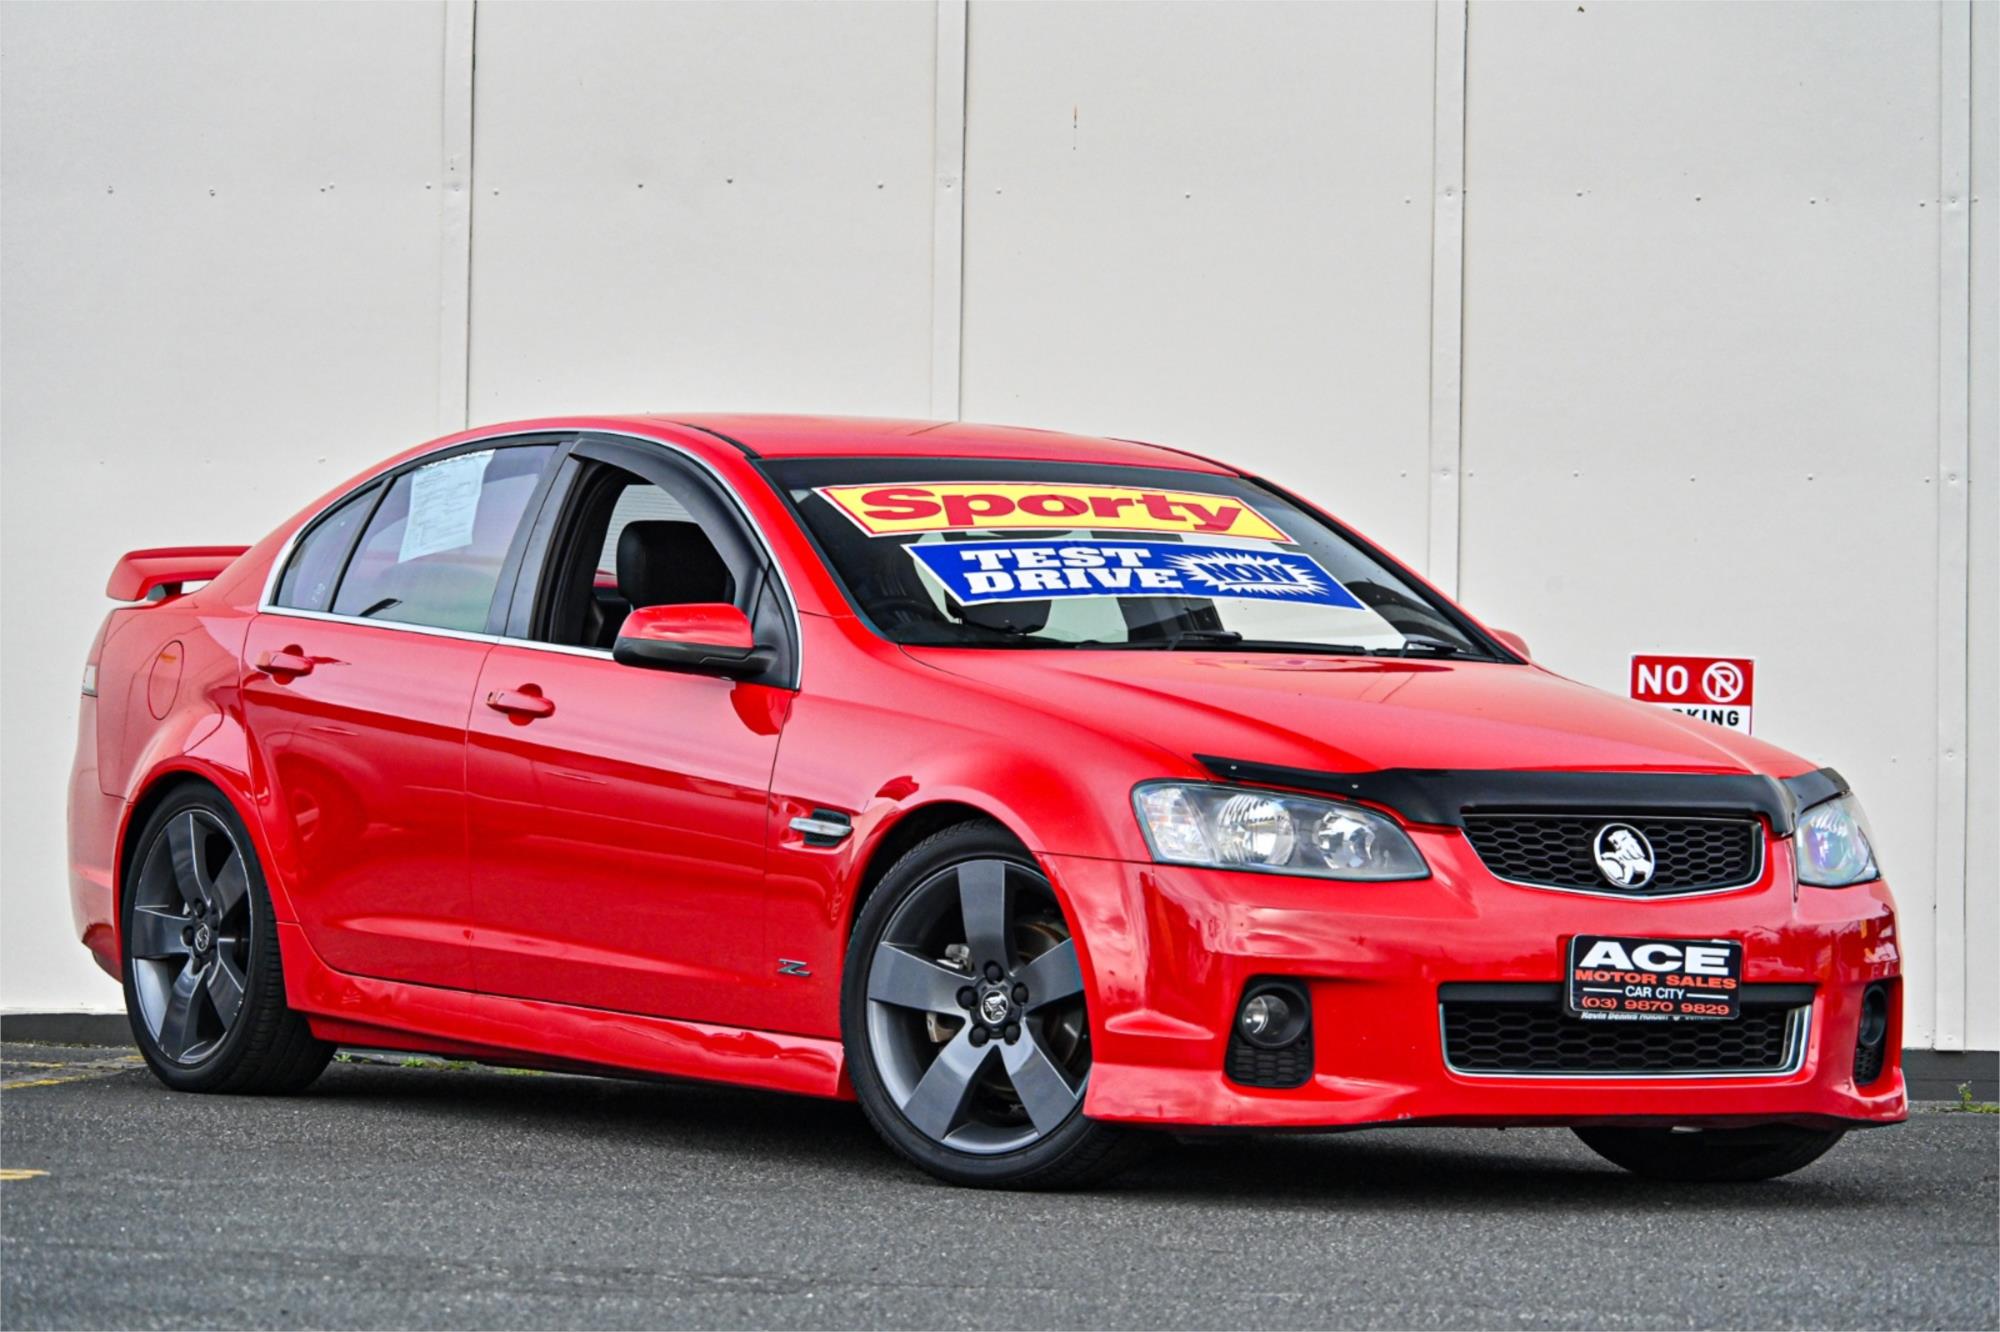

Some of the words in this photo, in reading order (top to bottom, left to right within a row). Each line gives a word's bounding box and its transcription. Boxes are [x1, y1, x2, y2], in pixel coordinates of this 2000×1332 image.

[861, 487, 1242, 532] Sporty
[961, 546, 1152, 571] TEST
[964, 568, 1184, 594] DRIVE
[1193, 562, 1299, 583] NOW
[1637, 663, 1689, 696] NO
[777, 958, 812, 977] Z
[1578, 941, 1731, 976] ACE
[1575, 970, 1658, 985] MOTOR
[1666, 974, 1737, 990] SALES
[1625, 985, 1652, 998] CAR
[1655, 987, 1685, 1000] CITY
[1581, 995, 1618, 1010] (03)
[1624, 998, 1674, 1013] 9870
[1680, 1001, 1730, 1016] 9829
